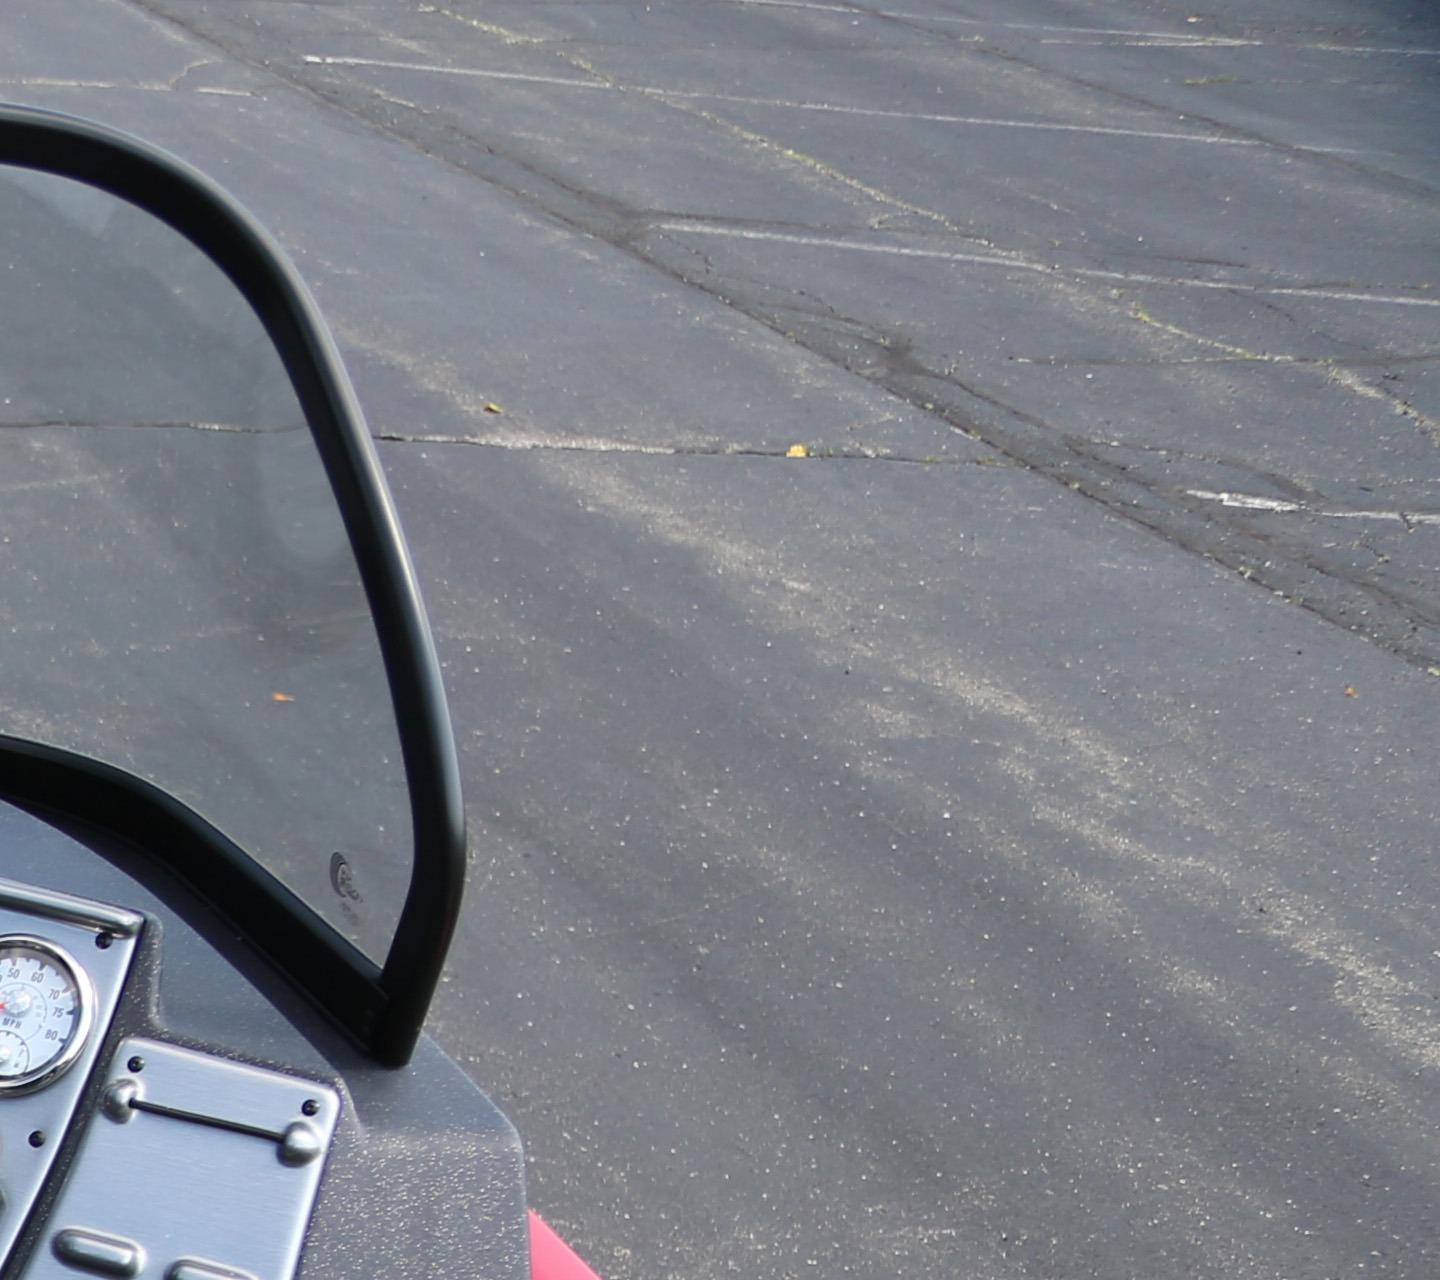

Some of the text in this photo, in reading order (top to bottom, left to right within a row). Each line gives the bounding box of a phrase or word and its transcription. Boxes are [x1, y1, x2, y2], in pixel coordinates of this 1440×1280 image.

[7, 968, 20, 979] 50
[31, 972, 44, 983] 60
[48, 988, 60, 1000] 70
[52, 1007, 64, 1017] 75
[2, 1018, 22, 1029] MPH
[45, 1029, 58, 1041] 80
